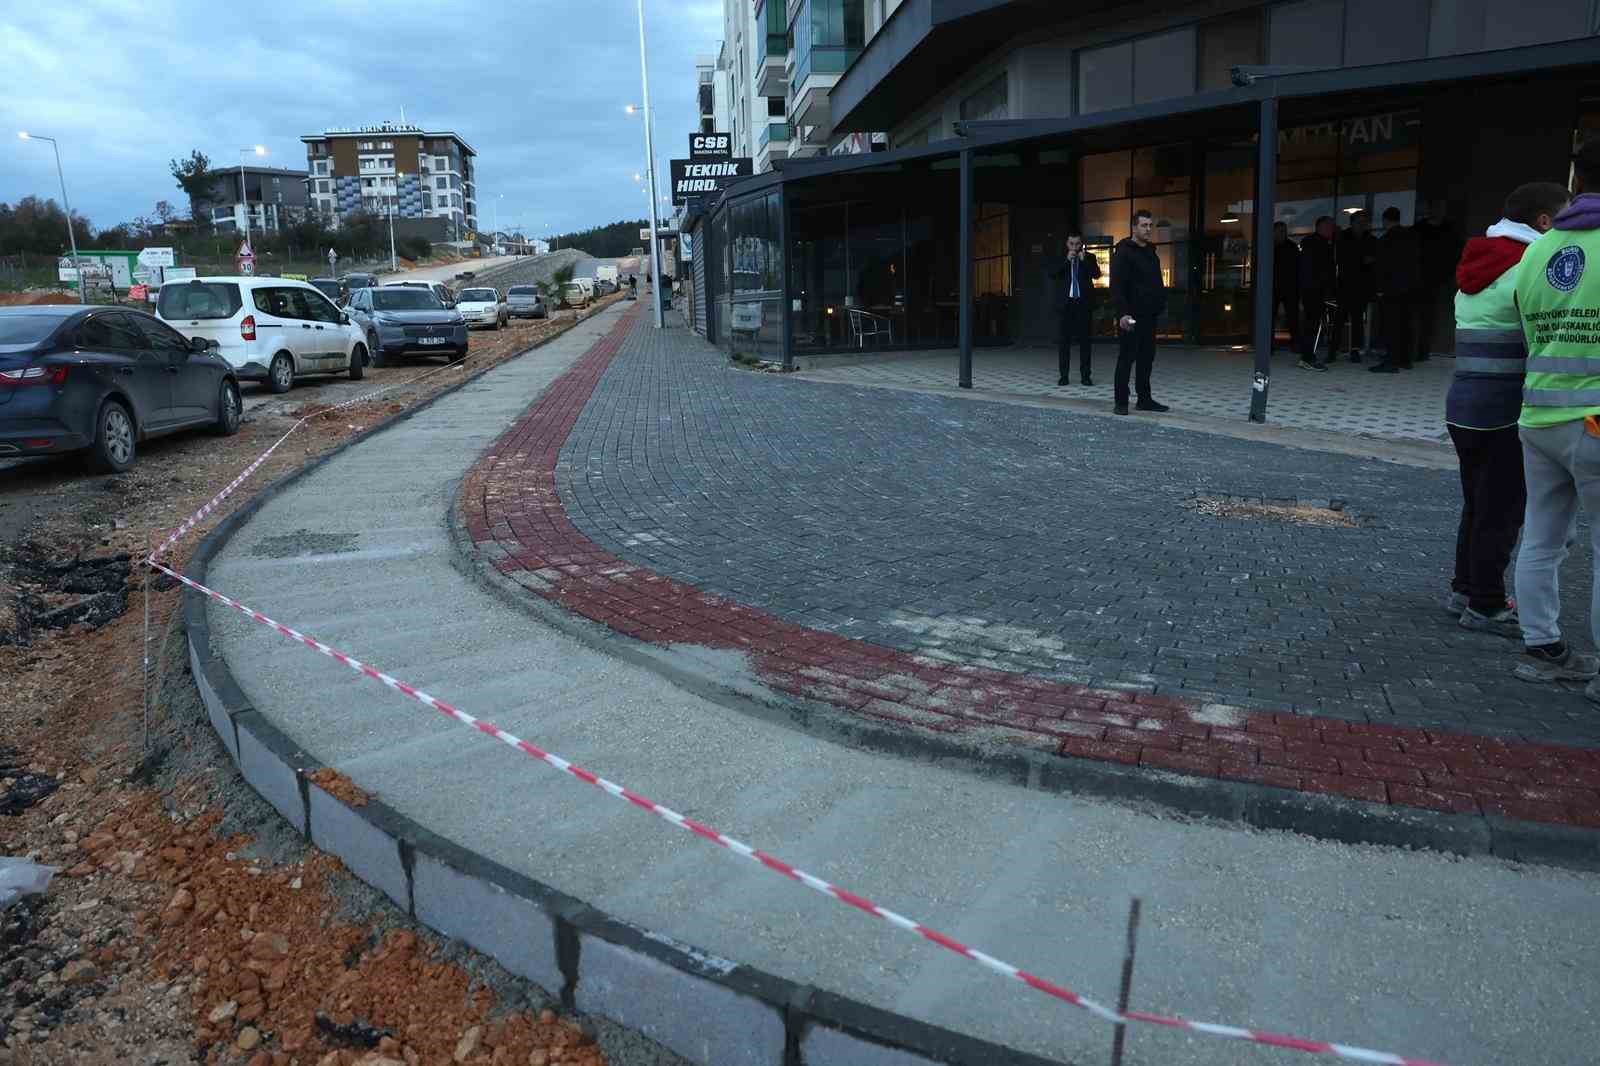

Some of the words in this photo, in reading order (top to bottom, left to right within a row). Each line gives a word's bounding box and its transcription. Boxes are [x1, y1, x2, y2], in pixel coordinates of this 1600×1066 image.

[694, 136, 728, 149] CSB
[684, 162, 739, 177] TEKNİK
[243, 263, 252, 271] 10
